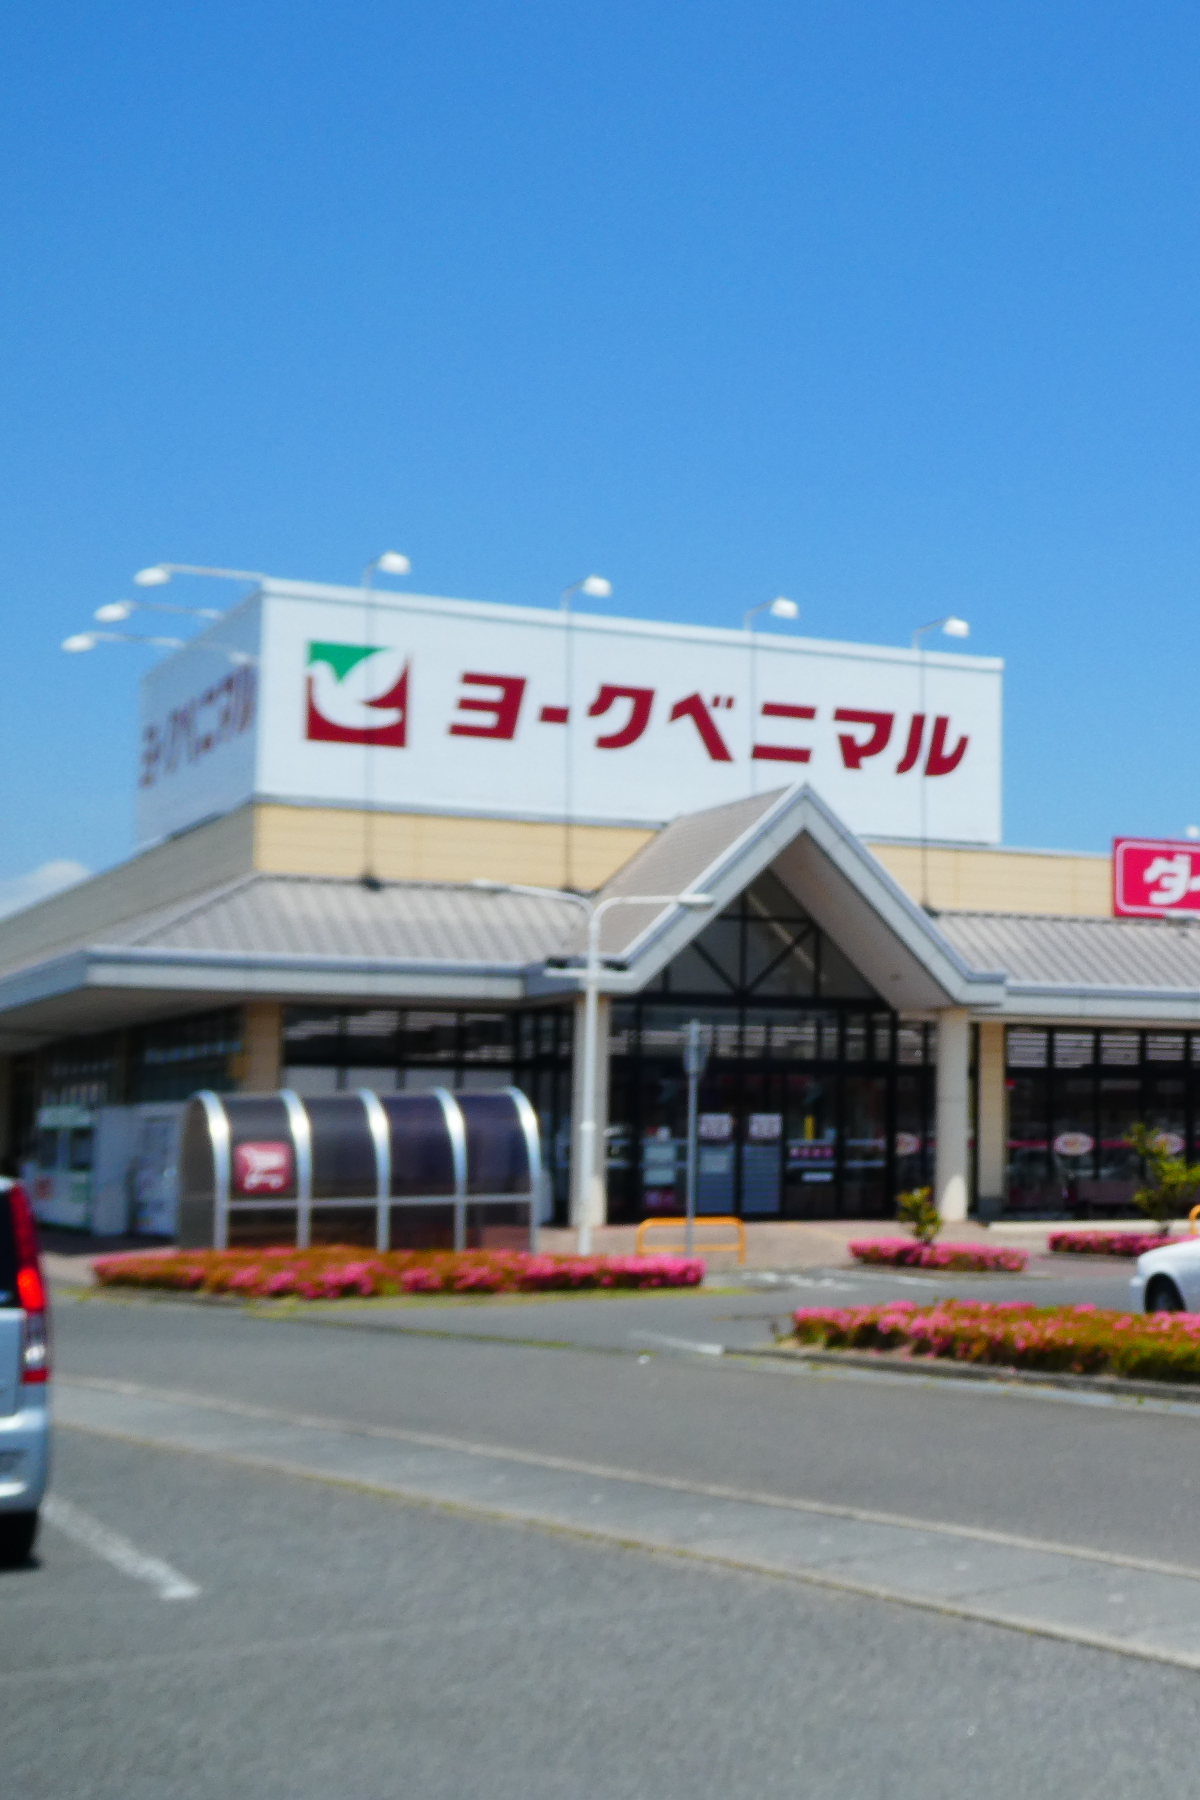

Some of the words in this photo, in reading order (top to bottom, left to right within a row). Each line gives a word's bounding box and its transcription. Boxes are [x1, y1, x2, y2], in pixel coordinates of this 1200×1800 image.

[448, 671, 969, 777] ヨークベニマル
